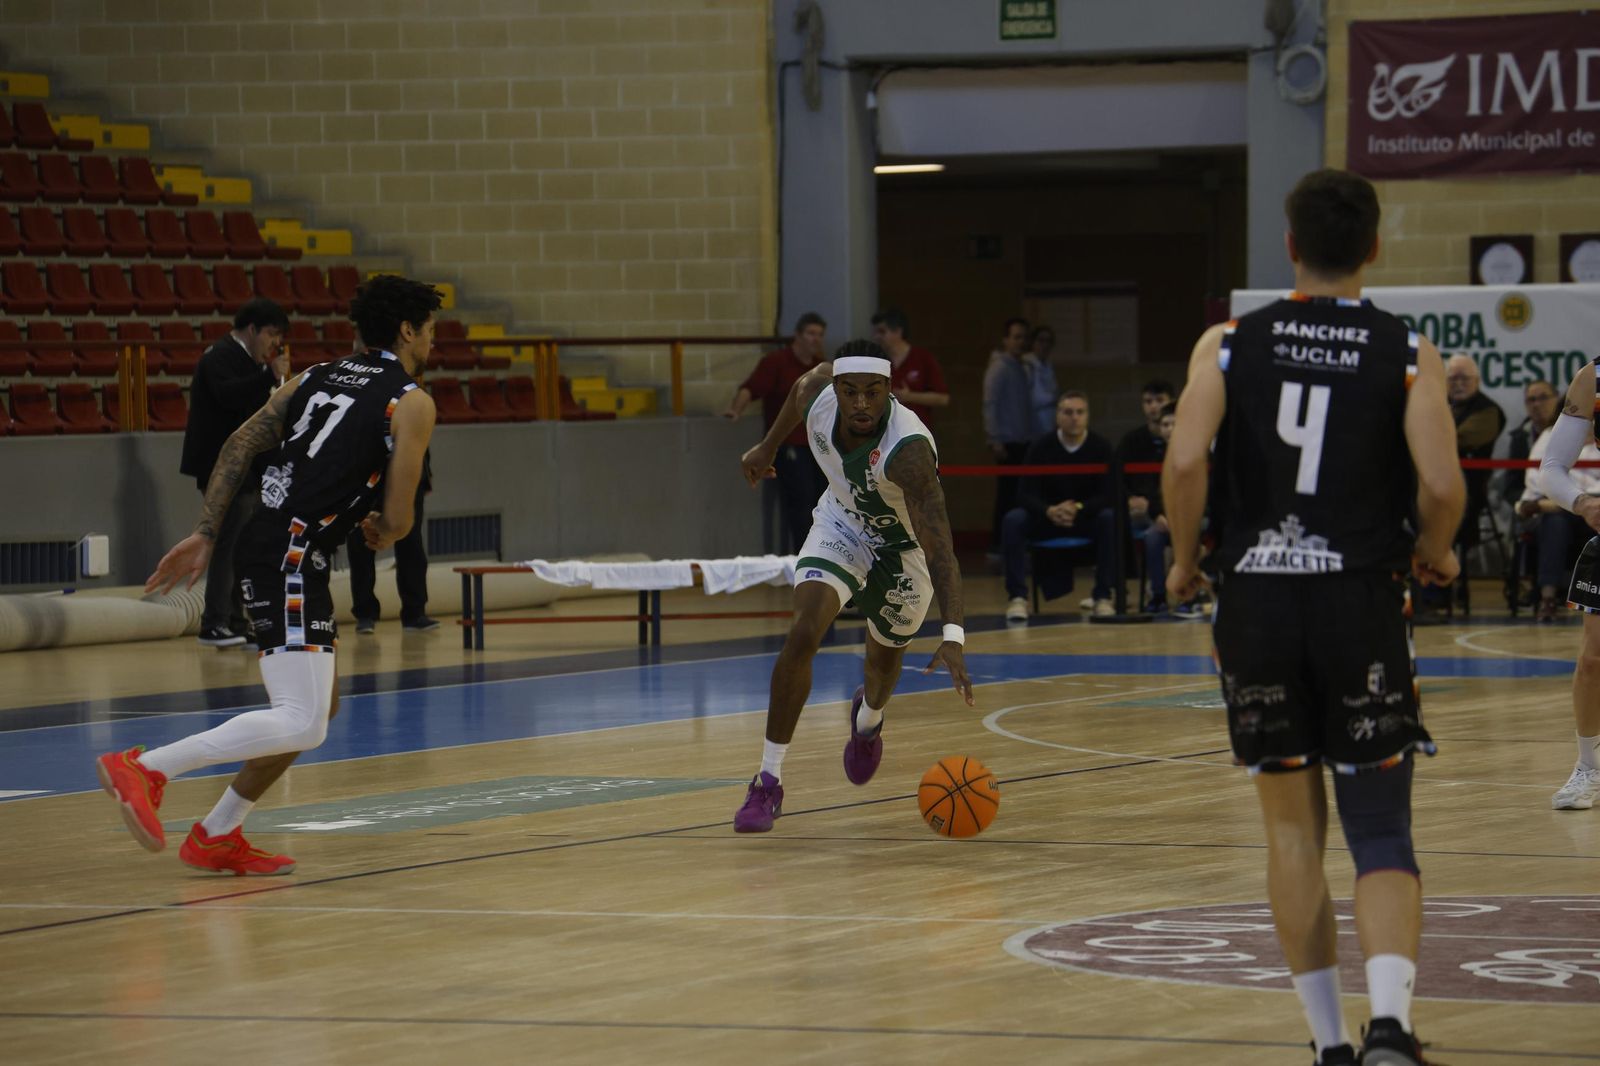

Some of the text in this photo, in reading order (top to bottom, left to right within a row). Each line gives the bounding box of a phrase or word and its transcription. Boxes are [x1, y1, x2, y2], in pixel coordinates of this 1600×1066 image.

[1367, 128, 1595, 154] Instituto Municipal de
[1272, 319, 1370, 344] SÁNCHEZ
[1290, 344, 1361, 367] UCLM
[1276, 380, 1332, 496] 4
[1236, 549, 1344, 572] ALBACETE
